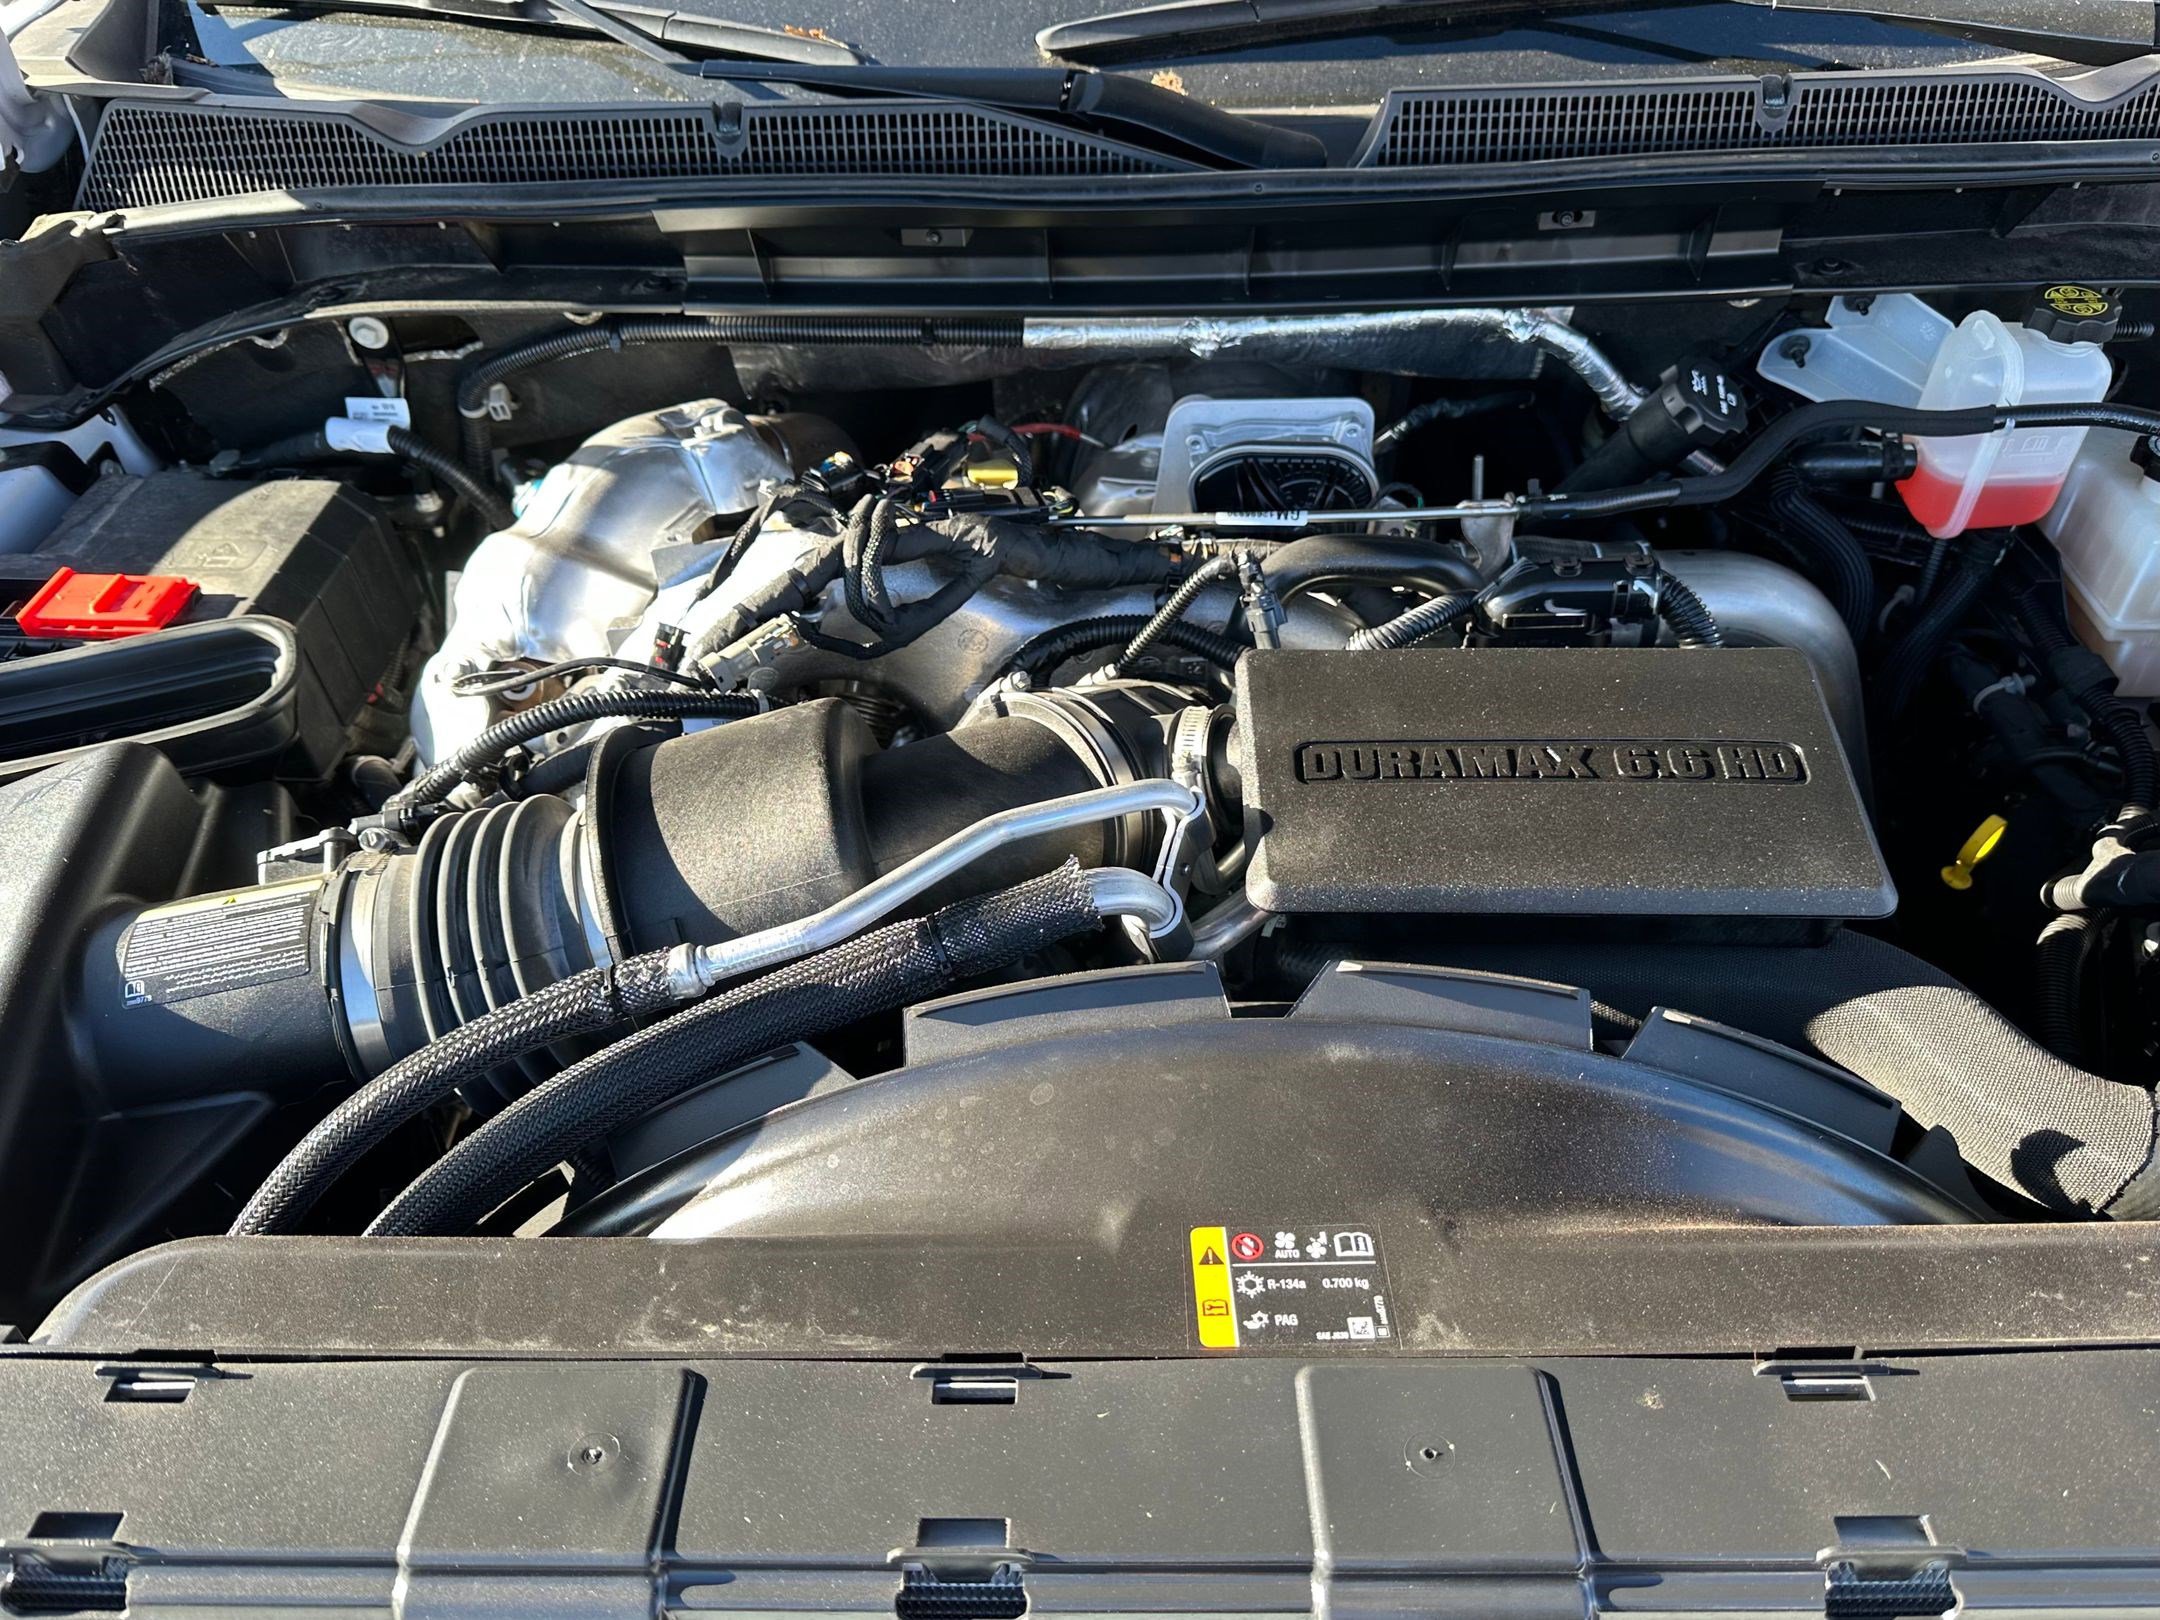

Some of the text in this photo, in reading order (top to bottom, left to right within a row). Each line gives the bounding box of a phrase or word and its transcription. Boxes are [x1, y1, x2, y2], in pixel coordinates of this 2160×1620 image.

[1301, 747, 1600, 780] DURAMAX
[1716, 747, 1804, 780] HD
[1274, 1249, 1300, 1259] AUTO
[1267, 1277, 1369, 1291] R-134a 0.700 kg
[1274, 1313, 1299, 1327] PAG
